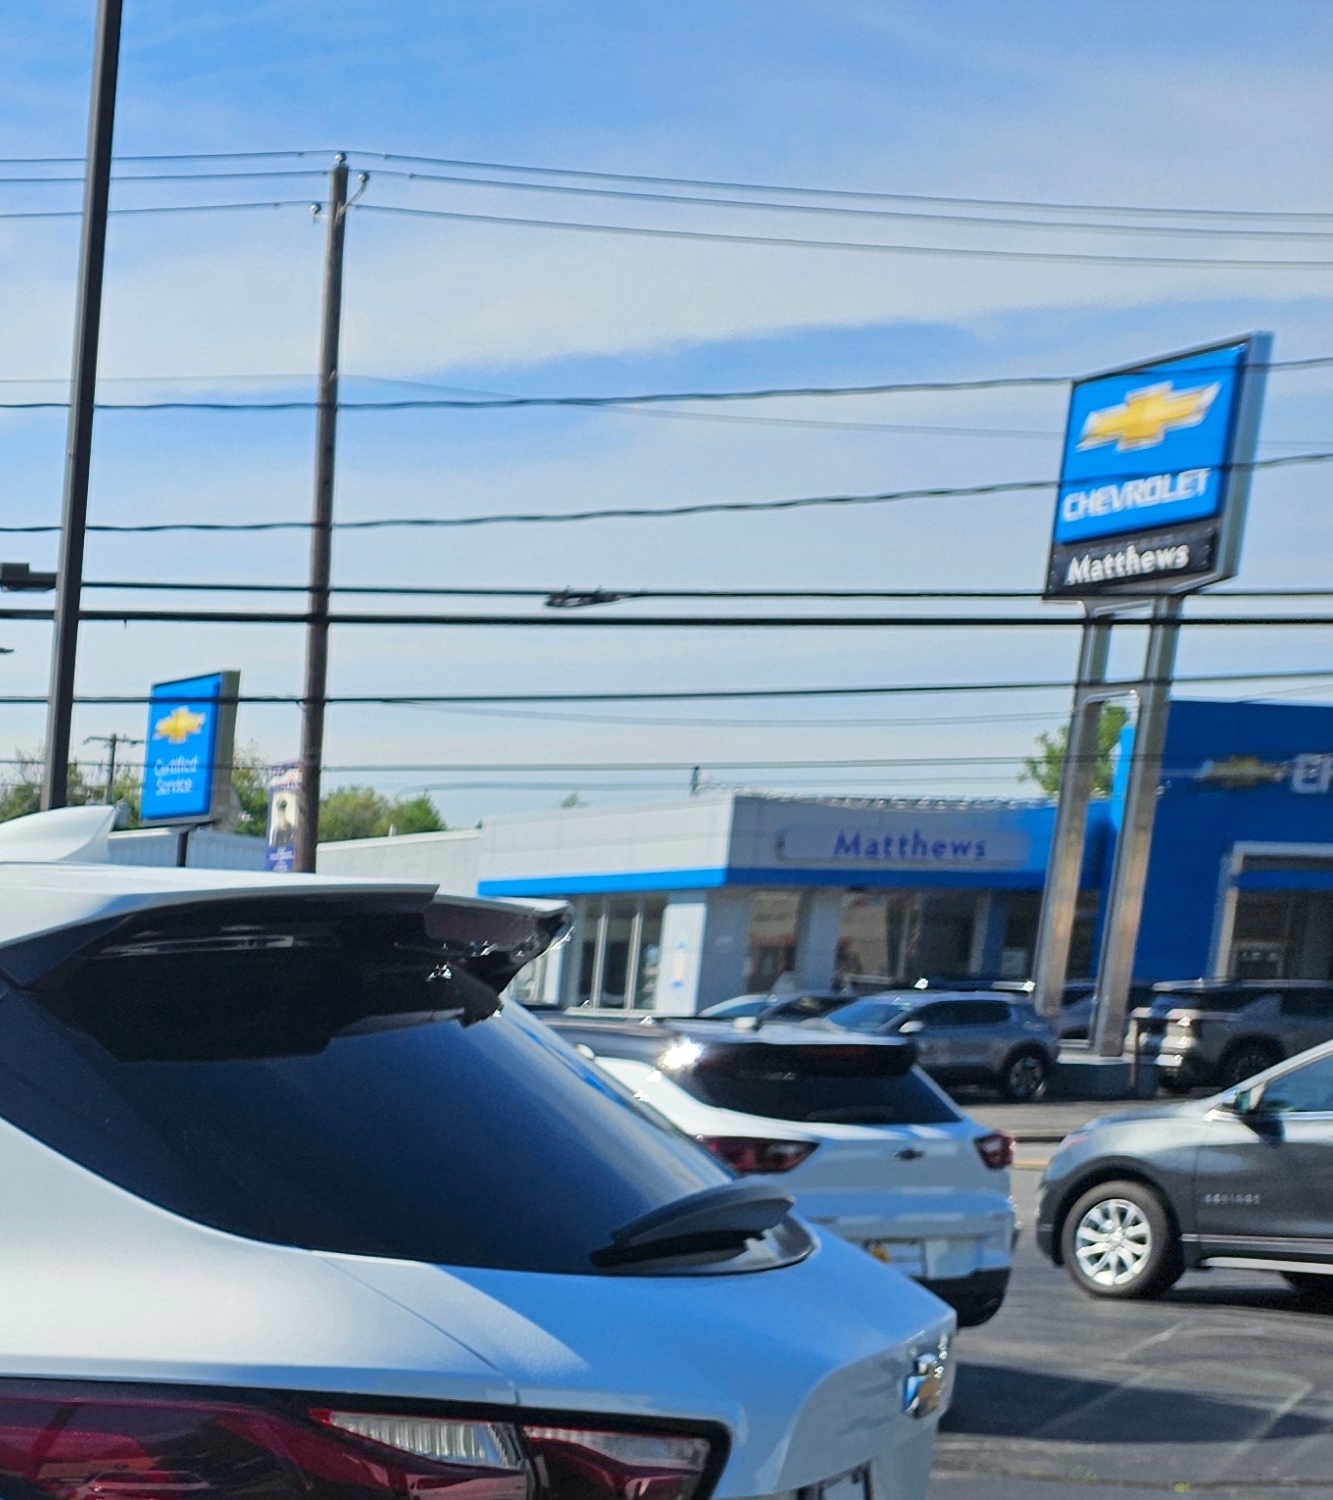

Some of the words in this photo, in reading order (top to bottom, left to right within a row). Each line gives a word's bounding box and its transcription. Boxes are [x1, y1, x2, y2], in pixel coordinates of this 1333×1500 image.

[1062, 468, 1211, 522] CHEVROLET
[1064, 544, 1190, 586] Matthews
[154, 754, 198, 777] Certified
[156, 777, 193, 797] Service
[834, 829, 988, 861] Matthews
